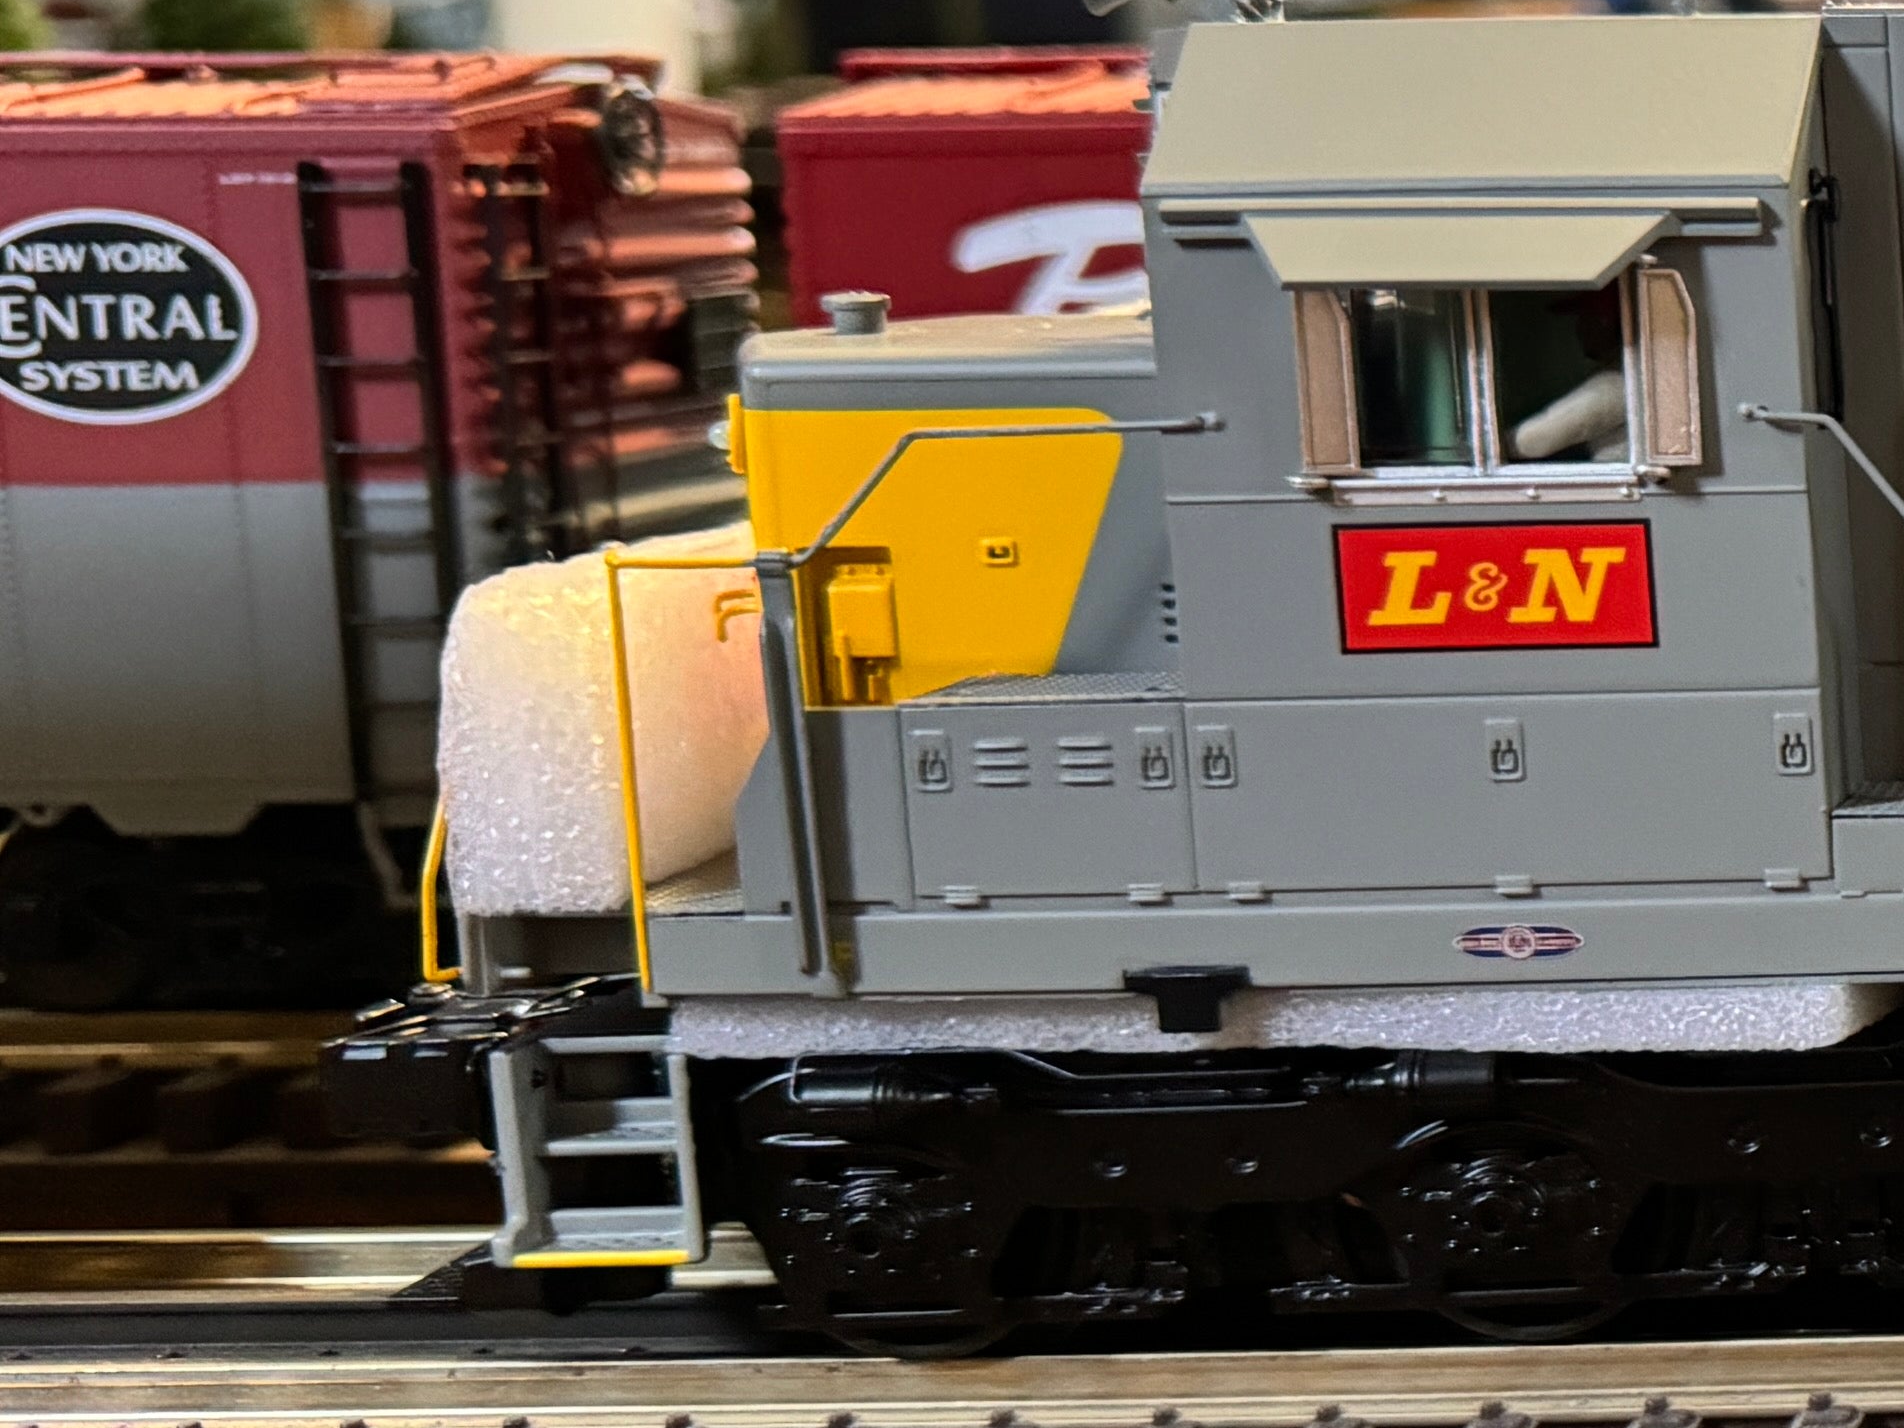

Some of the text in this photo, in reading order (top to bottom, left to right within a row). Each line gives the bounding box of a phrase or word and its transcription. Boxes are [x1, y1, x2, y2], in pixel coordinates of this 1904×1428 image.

[4, 240, 191, 273] NEW YORK
[18, 360, 201, 393] SYSTEM
[1367, 546, 1627, 627] L&N
